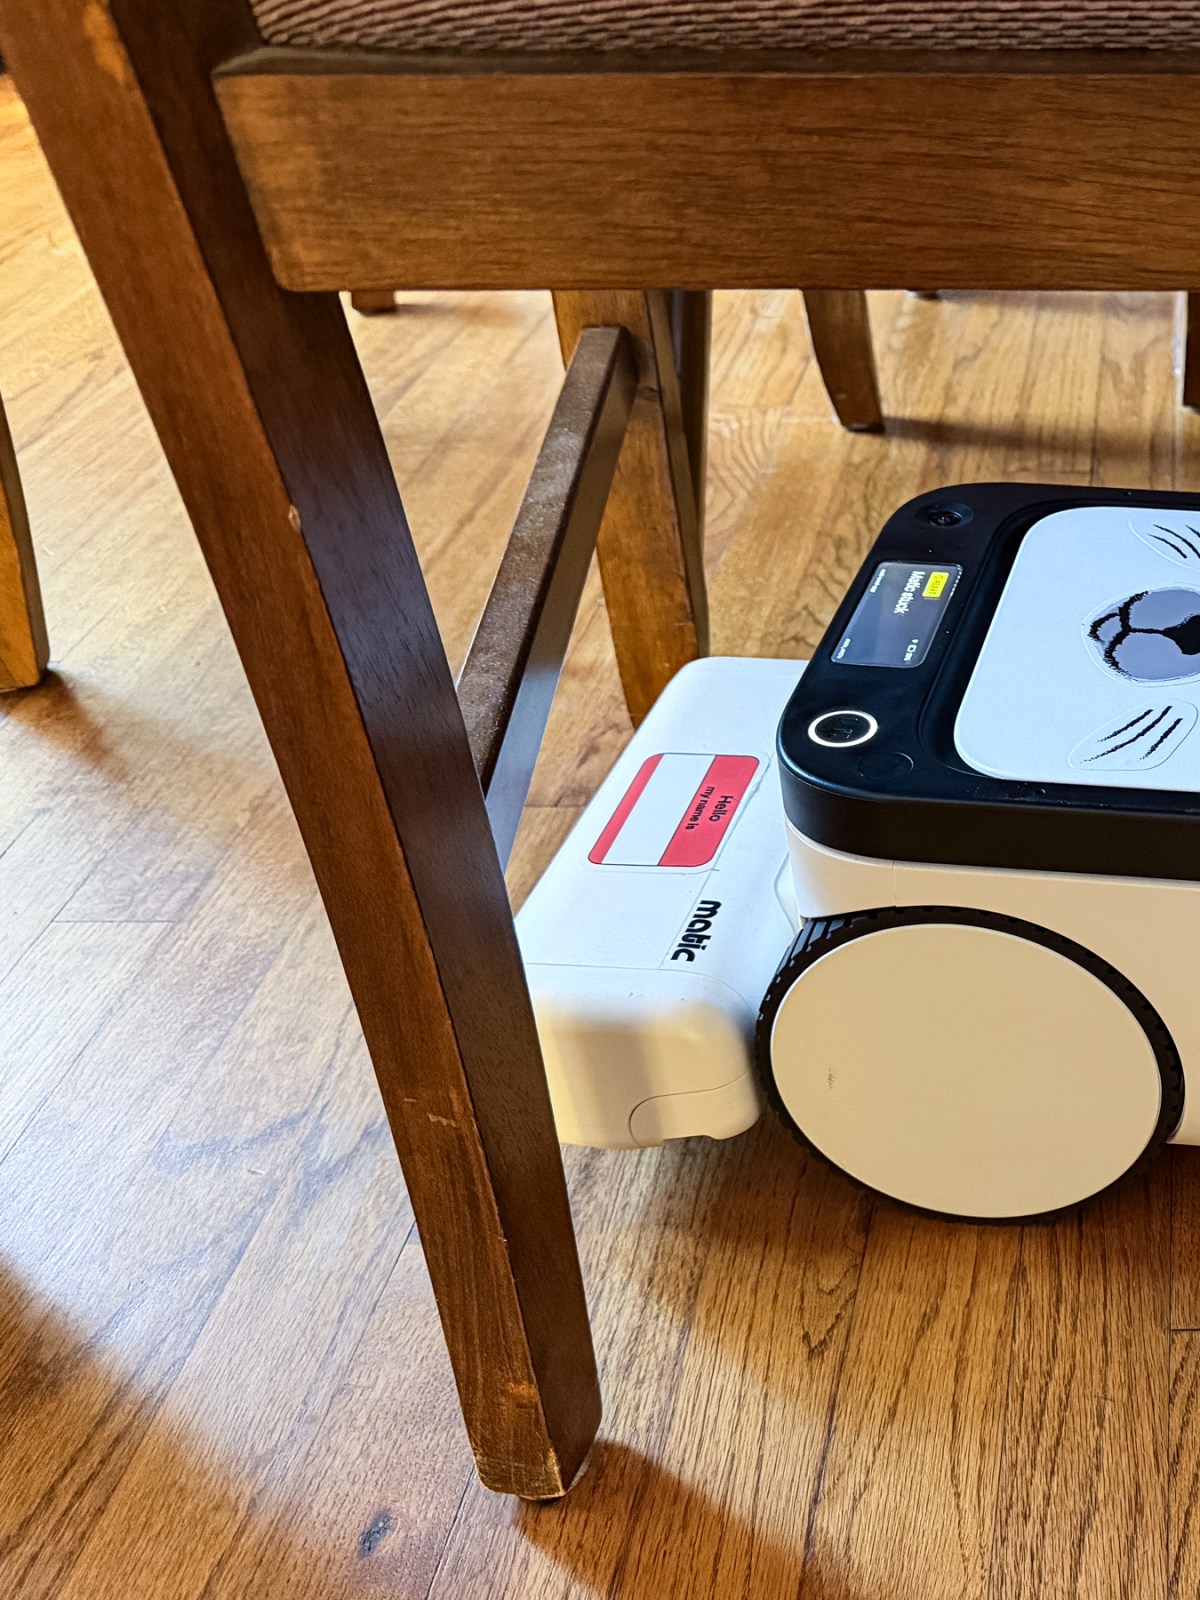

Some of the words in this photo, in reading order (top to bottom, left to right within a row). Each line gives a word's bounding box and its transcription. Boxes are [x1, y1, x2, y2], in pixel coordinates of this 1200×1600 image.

[903, 571, 925, 592] Matic
[893, 592, 914, 614] stuck
[700, 786, 715, 799] my
[689, 799, 708, 822] name
[709, 795, 734, 822] Hello
[685, 822, 700, 830] is
[670, 899, 722, 962] matic
